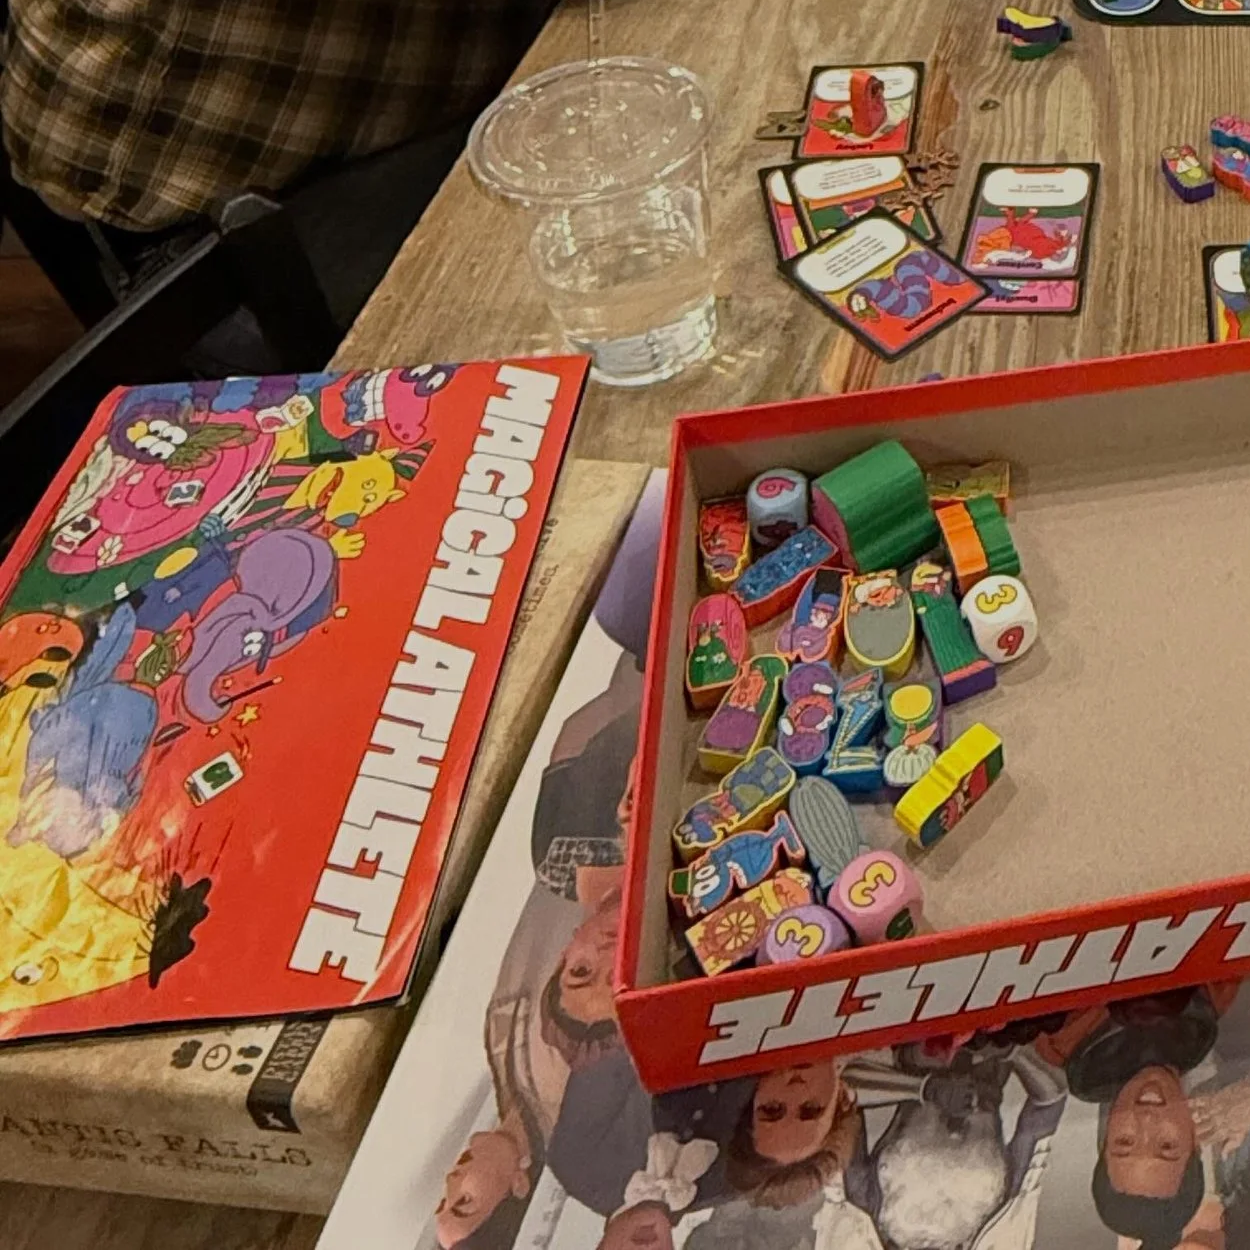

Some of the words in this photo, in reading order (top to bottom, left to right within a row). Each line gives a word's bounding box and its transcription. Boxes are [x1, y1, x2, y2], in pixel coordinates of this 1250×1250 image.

[976, 583, 1018, 615] 3
[288, 630, 468, 984] ATHLETE
[847, 862, 898, 909] 3
[775, 914, 826, 958] 3
[698, 905, 1226, 1064] ATHLETE
[140, 1153, 167, 1167] of
[157, 1132, 313, 1169] FALLS
